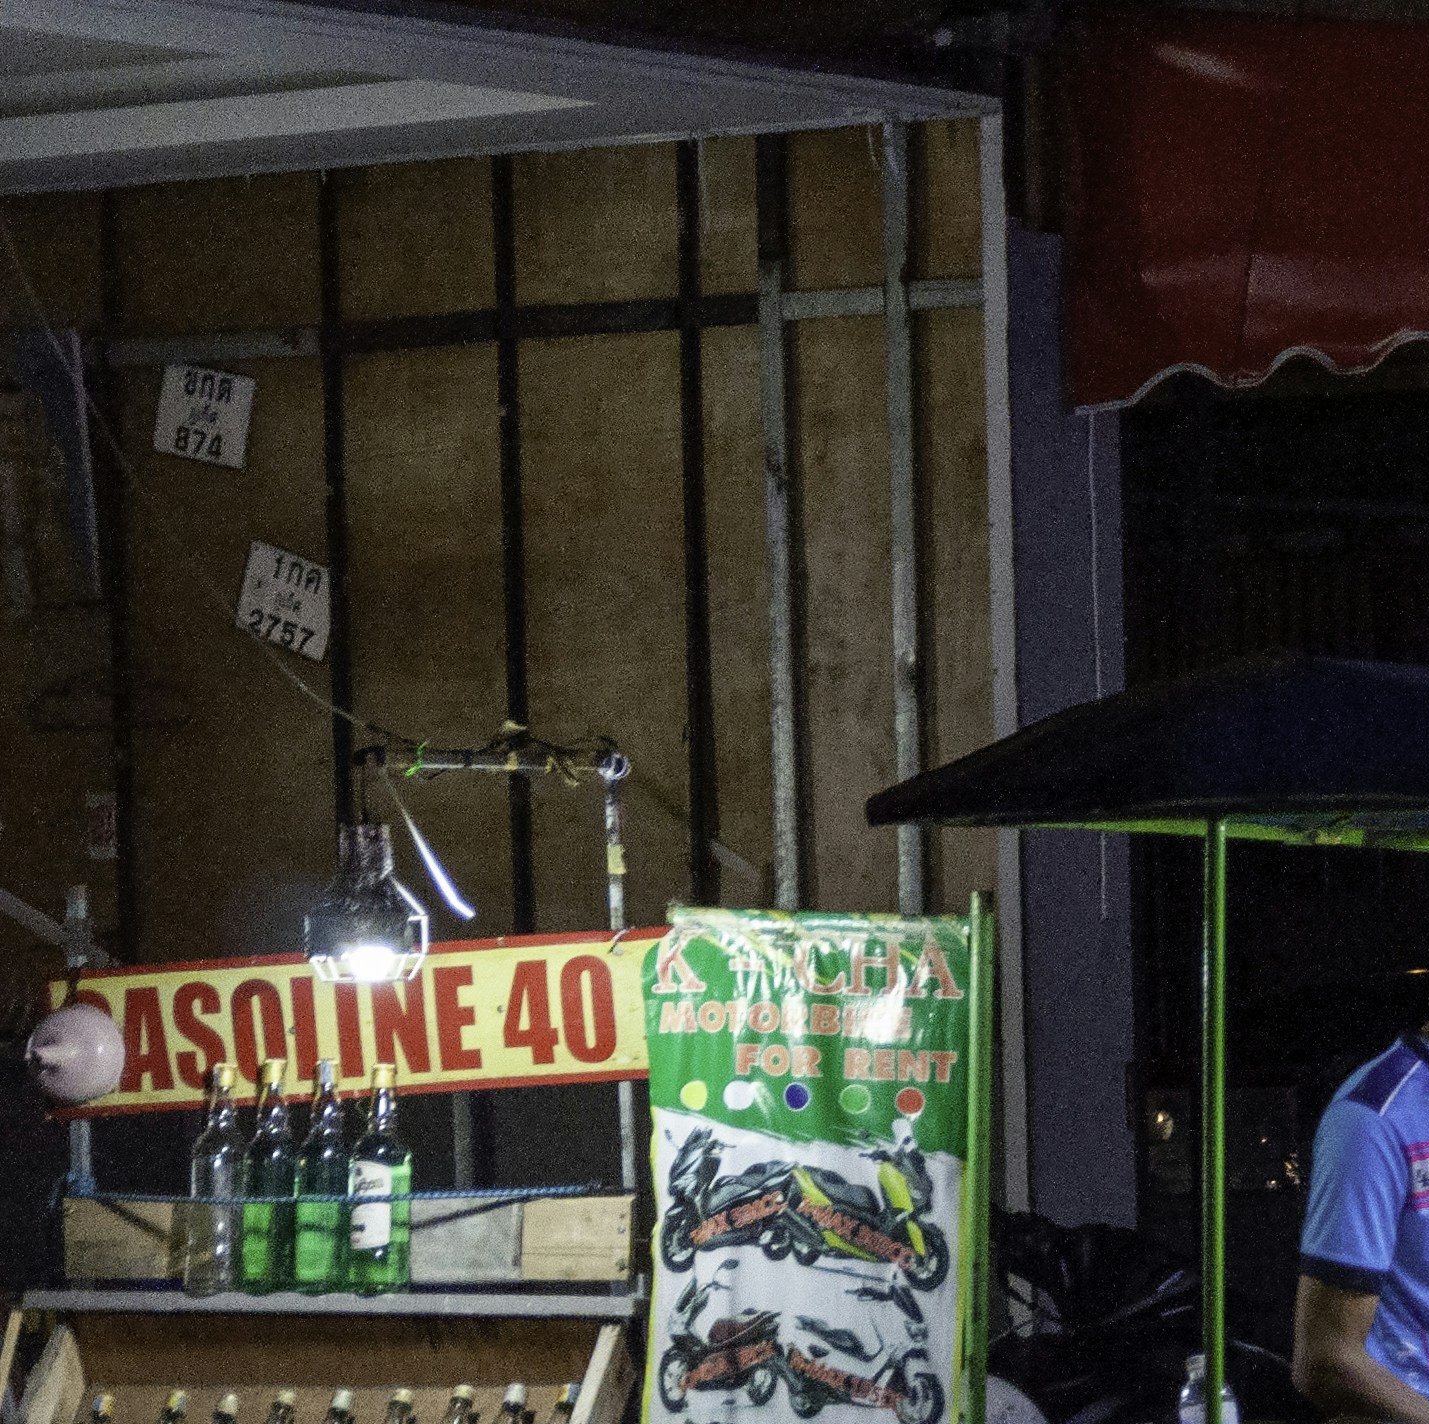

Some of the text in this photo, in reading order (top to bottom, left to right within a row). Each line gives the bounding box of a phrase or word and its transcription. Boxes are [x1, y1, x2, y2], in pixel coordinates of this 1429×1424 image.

[175, 425, 222, 456] 874
[248, 608, 315, 651] 2757
[651, 922, 707, 994] K
[793, 924, 965, 999] CHA
[76, 953, 617, 1094] ASOLINE 40
[658, 1000, 914, 1039] MOTORBIE
[735, 1043, 958, 1084] FOR RENT
